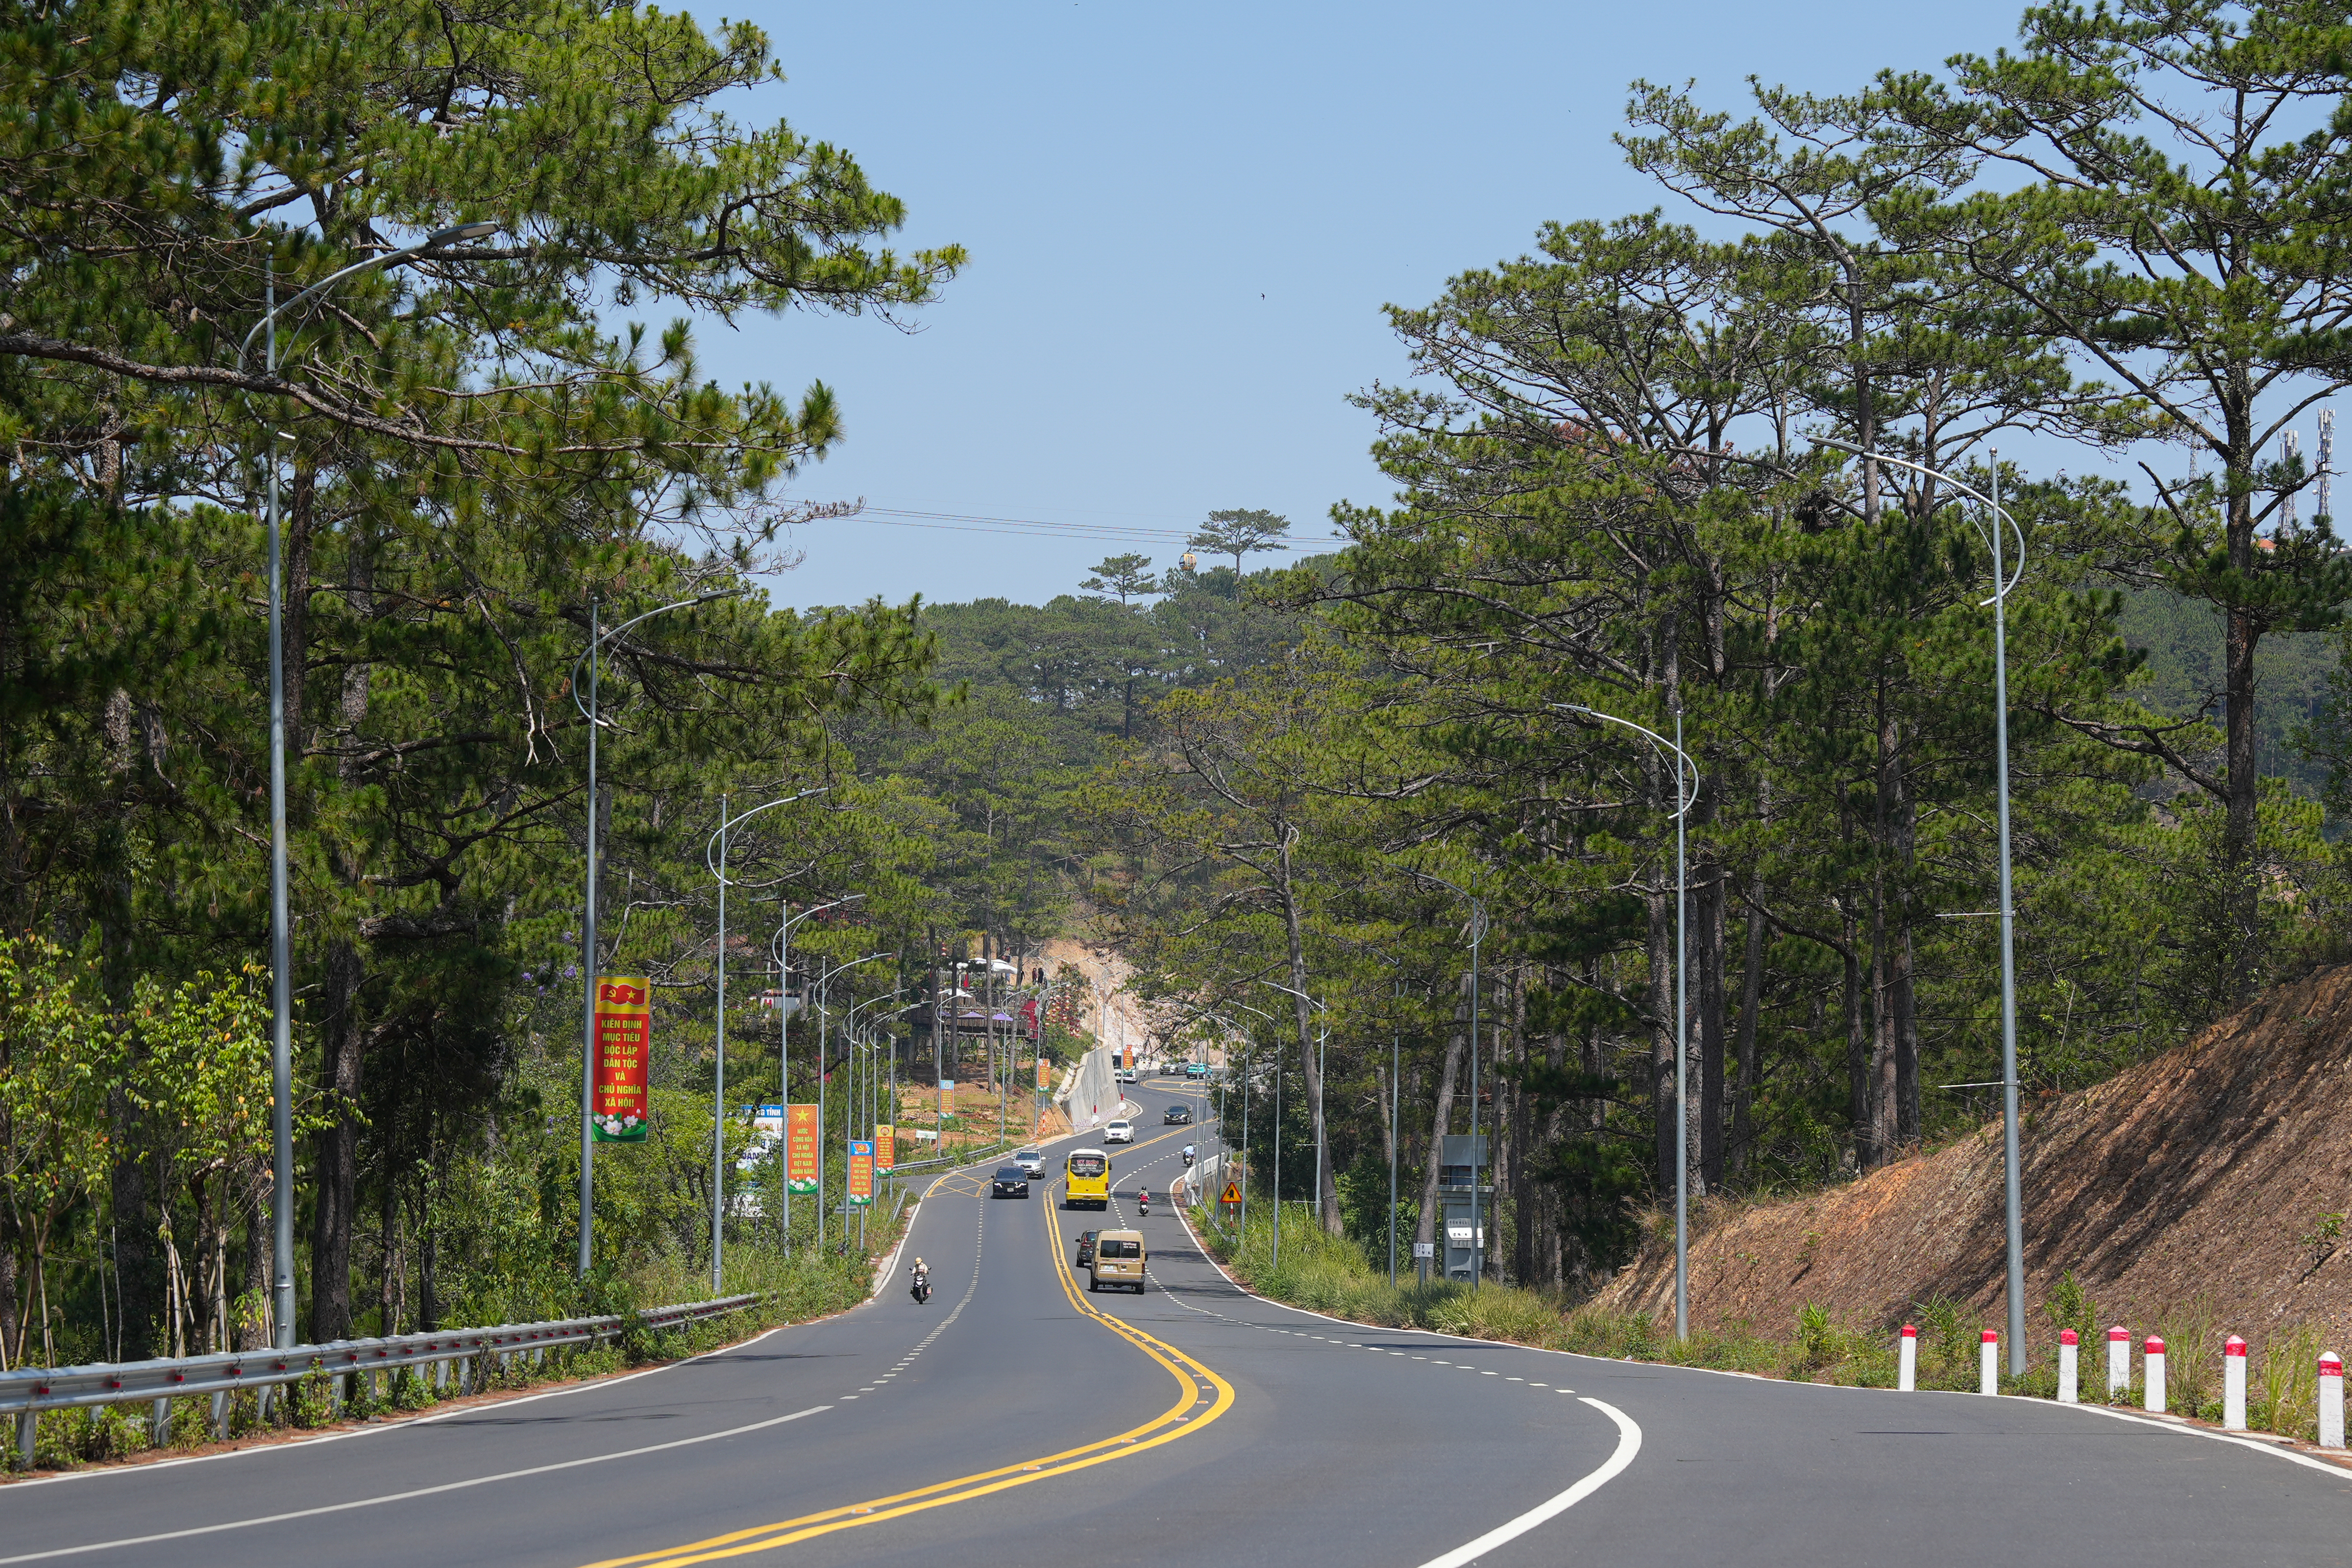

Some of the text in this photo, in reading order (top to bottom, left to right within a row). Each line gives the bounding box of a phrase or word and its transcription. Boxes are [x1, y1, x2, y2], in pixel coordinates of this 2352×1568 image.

[601, 1018, 642, 1031] KIÊN ĐỊNH
[602, 1032, 640, 1043] MỤC TIÊU
[604, 1044, 638, 1057] ĐỘC LẬP
[603, 1057, 638, 1070] DÂN TỘC
[615, 1070, 626, 1081] VÀ
[599, 1082, 642, 1094] CHỦ NGHĨA
[604, 1096, 634, 1109] XÃ HỘI!
